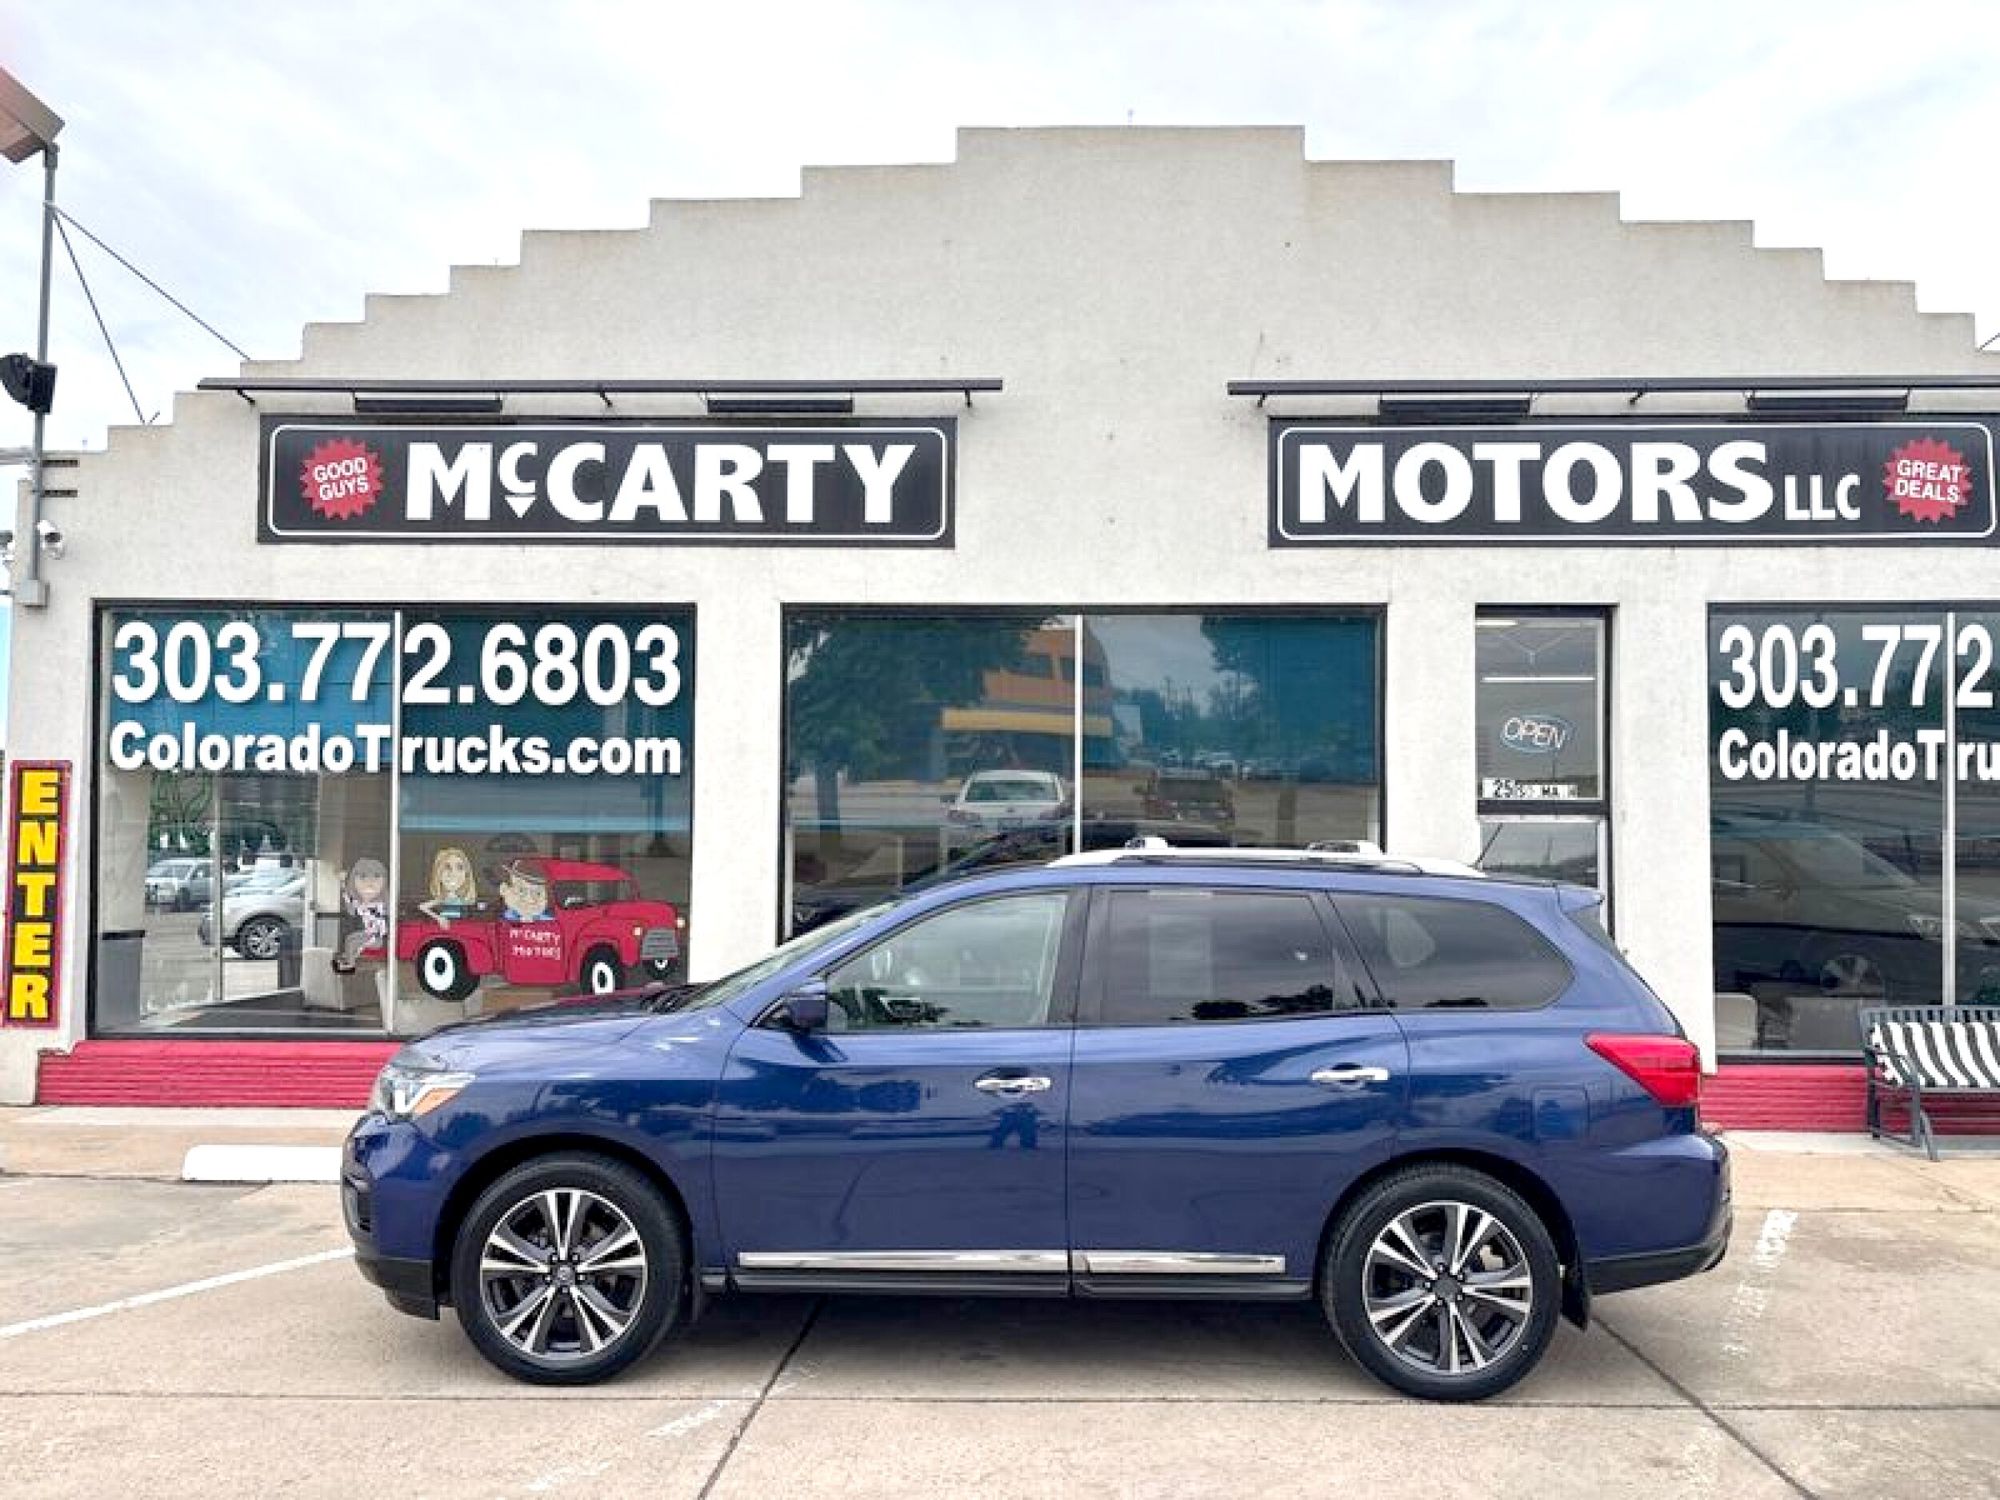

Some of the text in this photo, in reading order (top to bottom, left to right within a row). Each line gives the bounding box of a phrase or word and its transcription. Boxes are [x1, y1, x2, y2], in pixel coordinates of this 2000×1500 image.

[314, 457, 368, 483] GOOD
[319, 476, 369, 500] GUYS
[407, 442, 915, 522] McCARTY
[1300, 440, 1860, 522] MOTORS LLC
[1894, 478, 1959, 503] DEALS
[1897, 459, 1963, 483] GREAT
[112, 621, 681, 705] 303.772.6803
[109, 720, 681, 774] ColoradoTrucks.com
[1504, 717, 1566, 750] OPEN
[1719, 729, 2000, 780] ColoradoTru
[9, 770, 60, 1019] ENTER
